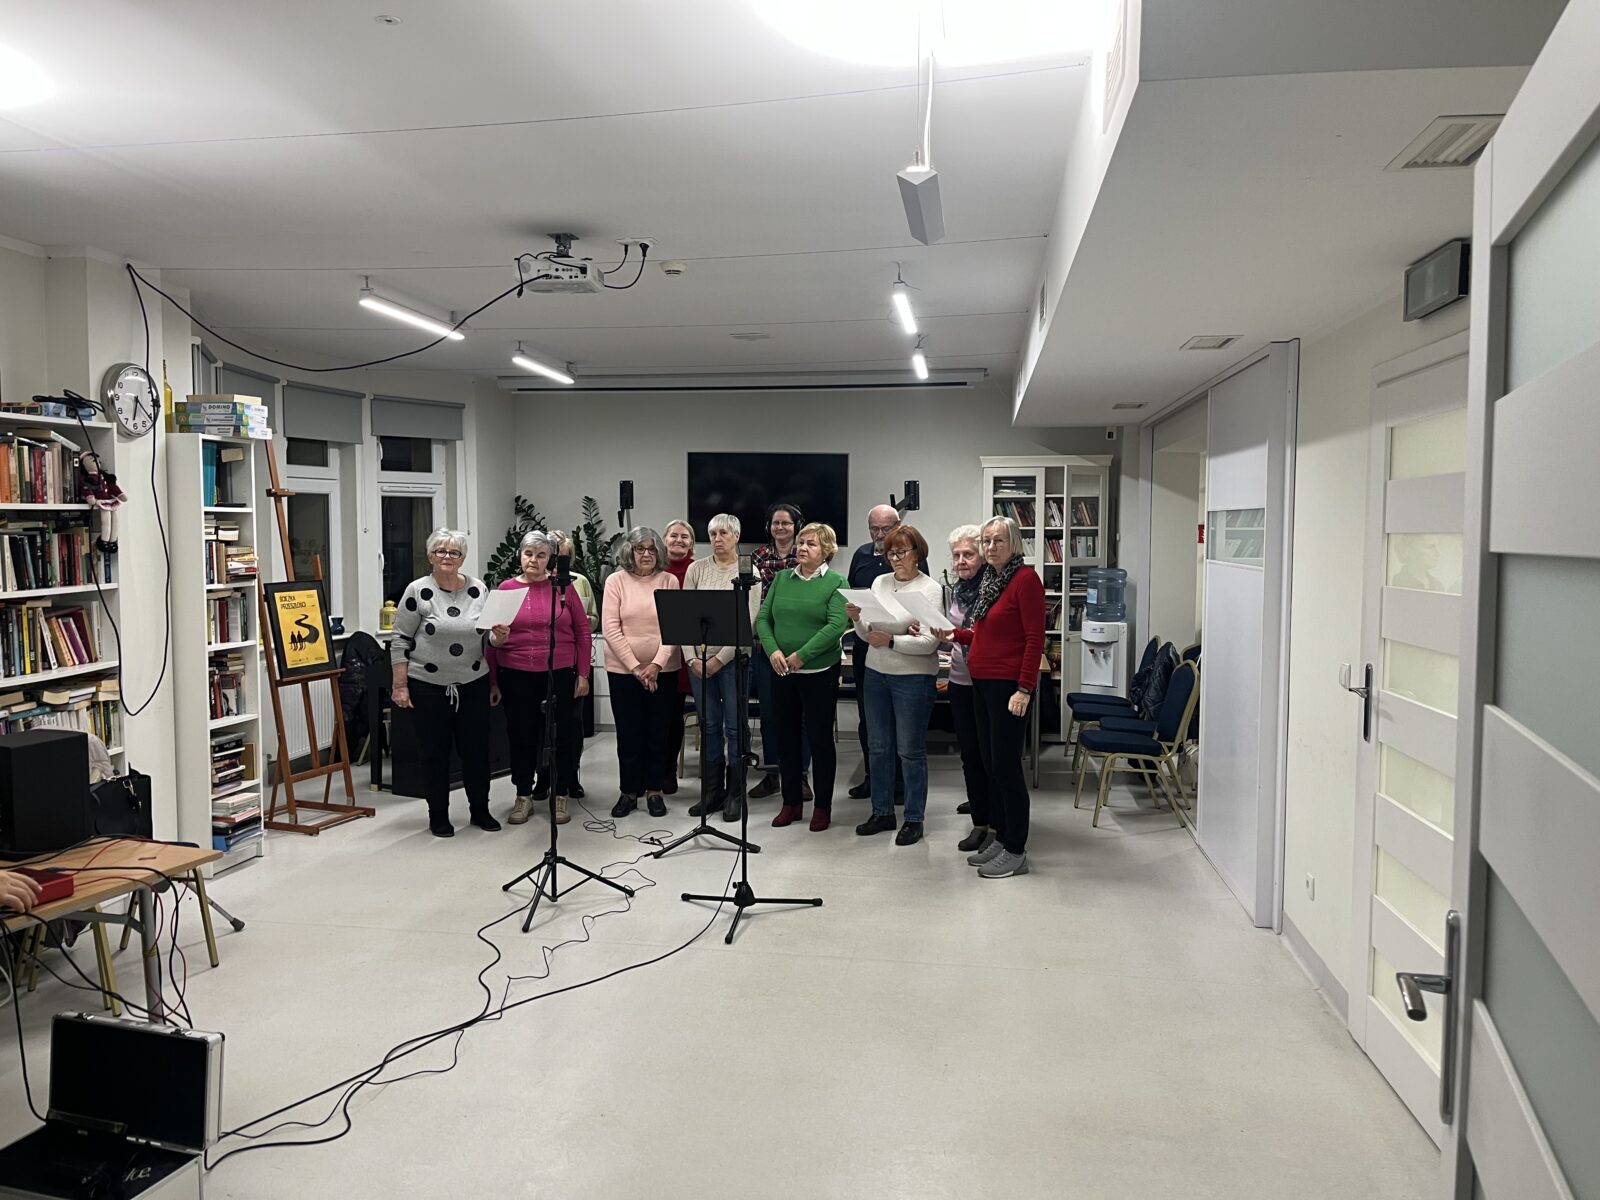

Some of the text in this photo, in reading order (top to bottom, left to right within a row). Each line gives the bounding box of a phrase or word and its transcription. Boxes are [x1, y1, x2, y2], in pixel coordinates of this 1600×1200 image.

[114, 393, 120, 401] 9
[117, 407, 123, 415] 8
[124, 417, 129, 425] 7
[141, 420, 147, 428] 5
[132, 422, 138, 430] 6
